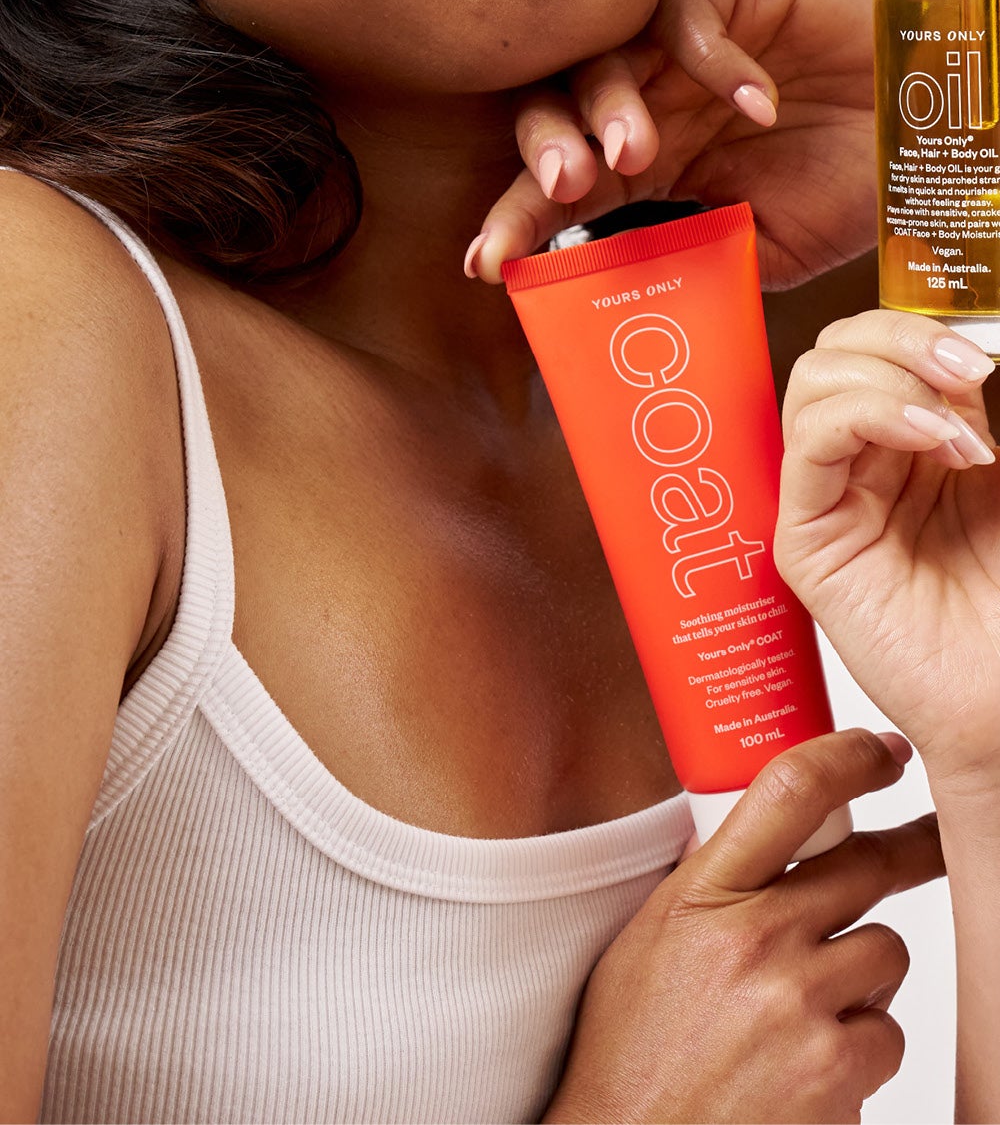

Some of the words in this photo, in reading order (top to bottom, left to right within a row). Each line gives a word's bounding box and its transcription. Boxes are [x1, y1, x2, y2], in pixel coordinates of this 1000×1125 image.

[900, 30, 941, 41] YOURS
[947, 30, 985, 41] ONLY
[899, 51, 982, 130] oil
[916, 135, 942, 145] Yours
[899, 147, 920, 159] Face,
[920, 148, 940, 158] Hair
[951, 149, 978, 160] Body
[980, 148, 999, 158] OIL
[904, 162, 918, 172] Hair
[925, 164, 946, 174] Body
[947, 164, 963, 173] OIL
[964, 164, 972, 173] is
[973, 165, 993, 174] your
[899, 174, 909, 184] dry
[910, 175, 925, 183] skin
[925, 176, 941, 184] and
[942, 176, 978, 185] parched
[908, 186, 914, 194] in
[915, 187, 936, 196] quick
[937, 187, 953, 195] and
[954, 187, 998, 195] nourishes
[905, 197, 931, 206] without
[932, 198, 960, 207] feeling
[961, 199, 993, 207] greasy.
[900, 206, 914, 215] nice
[914, 208, 930, 216] with
[930, 208, 970, 217] sensitive,
[929, 219, 949, 228] skin,
[949, 219, 966, 228] and
[967, 220, 990, 229] pairs
[894, 227, 912, 236] COAT
[912, 229, 930, 238] Face
[938, 230, 960, 240] Body
[931, 246, 963, 258] Vegan.
[908, 261, 931, 272] Made
[932, 263, 941, 272] in
[942, 263, 992, 273] Australia.
[926, 277, 946, 289] 125
[948, 277, 968, 289] mL
[591, 290, 641, 309] YOURS
[646, 277, 682, 296] ONLY
[609, 313, 765, 598] coat
[679, 611, 724, 629] Soothing
[724, 595, 775, 617] moisturiser
[672, 633, 692, 645] that
[692, 627, 714, 640] tells
[713, 622, 738, 636] your
[737, 615, 757, 628] skin
[757, 612, 767, 621] to
[697, 649, 727, 661] Yours
[756, 630, 783, 646] COAT
[688, 658, 766, 686] Dermatologically
[767, 649, 796, 664] tested.
[706, 684, 722, 695] For
[724, 672, 765, 690] sensitive
[766, 666, 787, 678] skin.
[705, 693, 741, 708] Cruelty
[741, 688, 764, 700] free.
[764, 678, 794, 692] Vegan.
[713, 721, 742, 734] Made
[743, 718, 752, 727] in
[754, 704, 798, 724] Australia.
[739, 733, 763, 748] 100
[765, 727, 785, 742] mL
